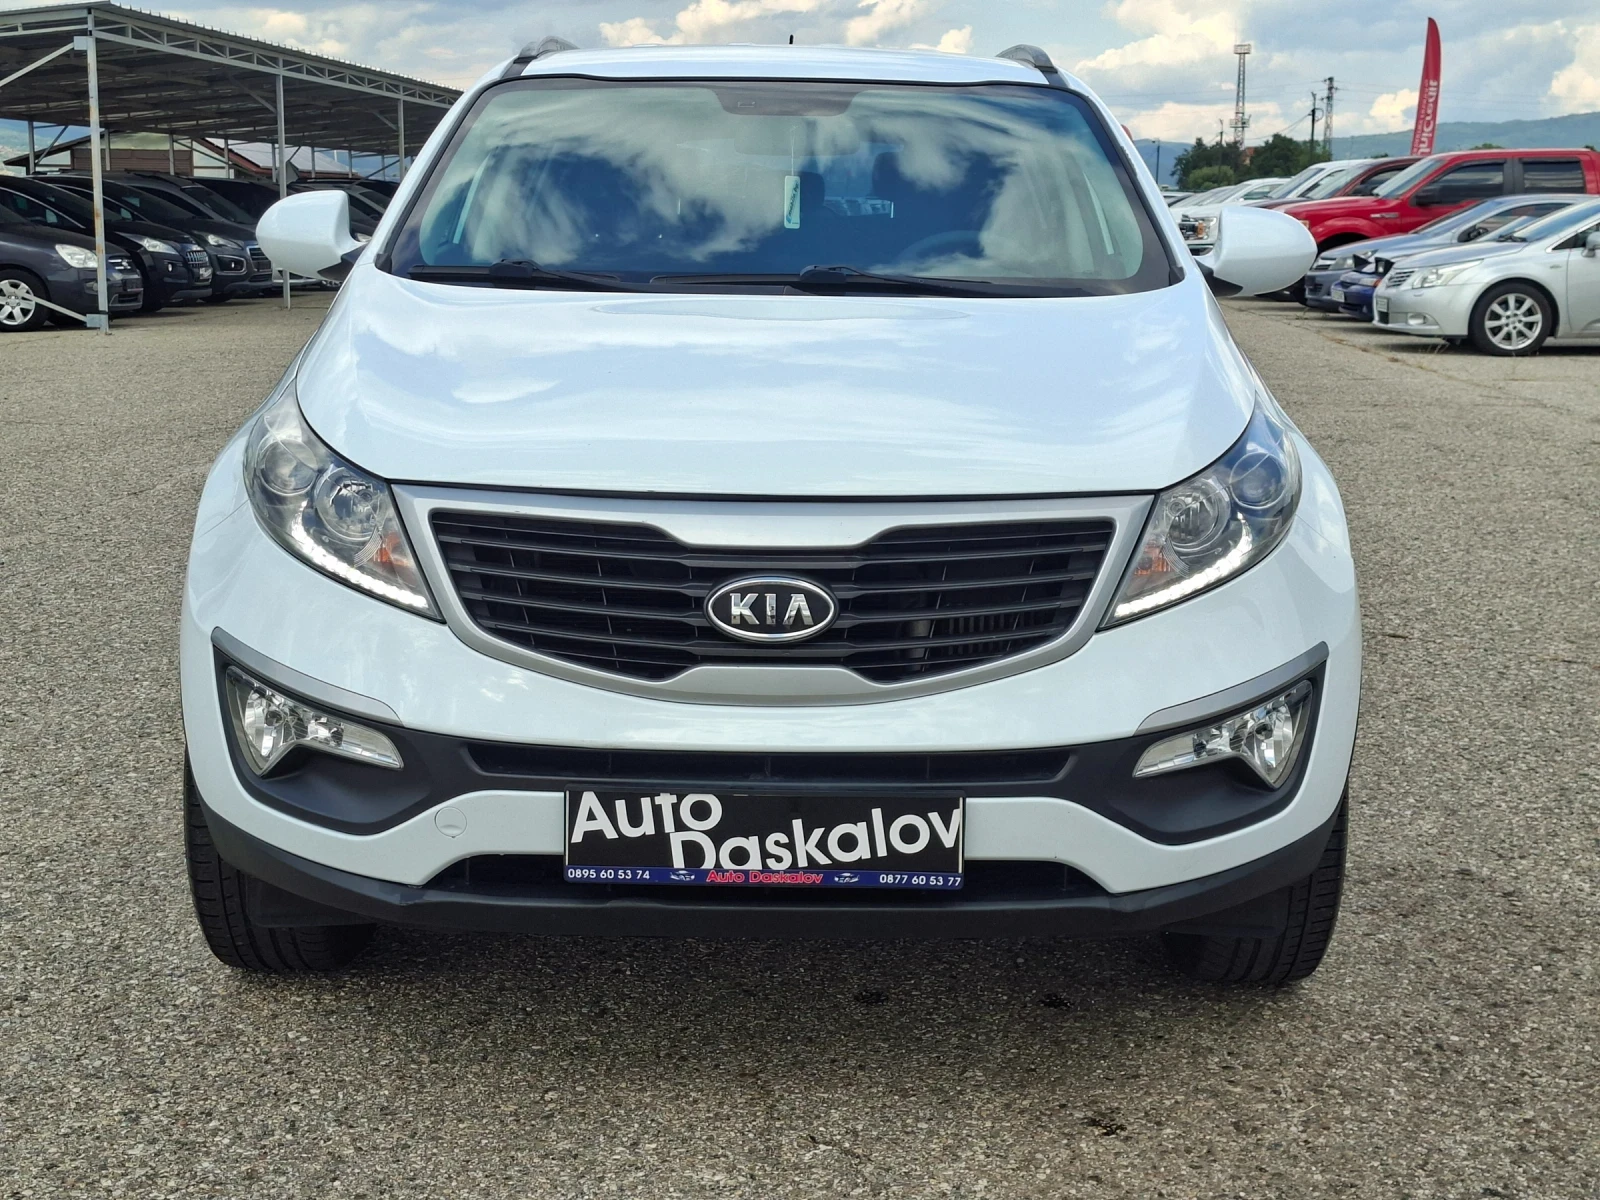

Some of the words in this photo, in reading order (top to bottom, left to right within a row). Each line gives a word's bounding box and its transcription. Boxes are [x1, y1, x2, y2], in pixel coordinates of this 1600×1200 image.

[729, 592, 814, 625] KIA
[570, 791, 723, 843] Auto
[669, 808, 961, 871] Daskalov
[567, 868, 597, 879] 0895
[600, 869, 615, 879] 60
[617, 870, 632, 879] 53
[636, 870, 651, 879] 74
[706, 870, 745, 882] Auto
[749, 871, 824, 884] Daskalov
[879, 874, 908, 884] 0877
[911, 875, 926, 885] 60
[929, 876, 944, 886] 53
[947, 877, 961, 886] 77
